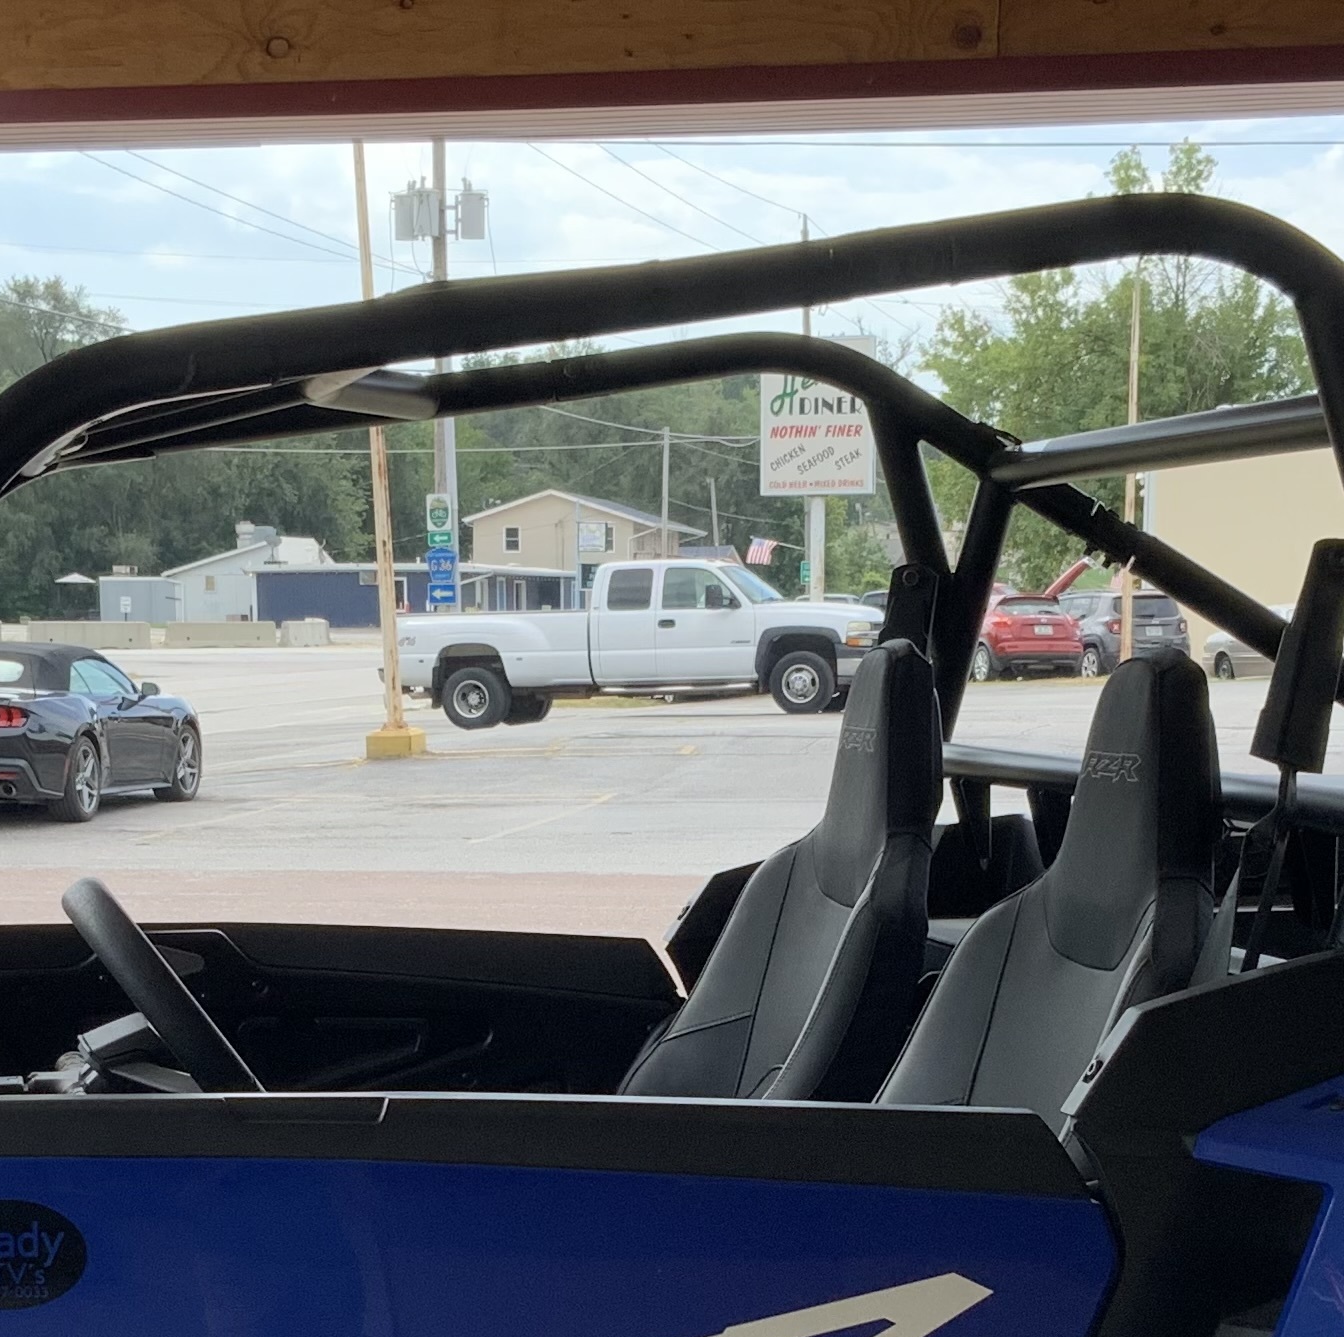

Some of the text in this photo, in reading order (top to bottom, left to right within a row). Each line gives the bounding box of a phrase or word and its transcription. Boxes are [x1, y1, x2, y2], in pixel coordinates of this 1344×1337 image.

[799, 396, 863, 416] DINER
[770, 424, 863, 439] NOTHIN' FINER
[770, 443, 807, 472] CHICKEN
[797, 446, 835, 475] SEAFOOD
[835, 448, 863, 471] STEAK
[769, 481, 787, 489] COLD
[814, 480, 836, 488] MIXED
[837, 479, 864, 488] DRINKS
[1080, 751, 1142, 784] RZR
